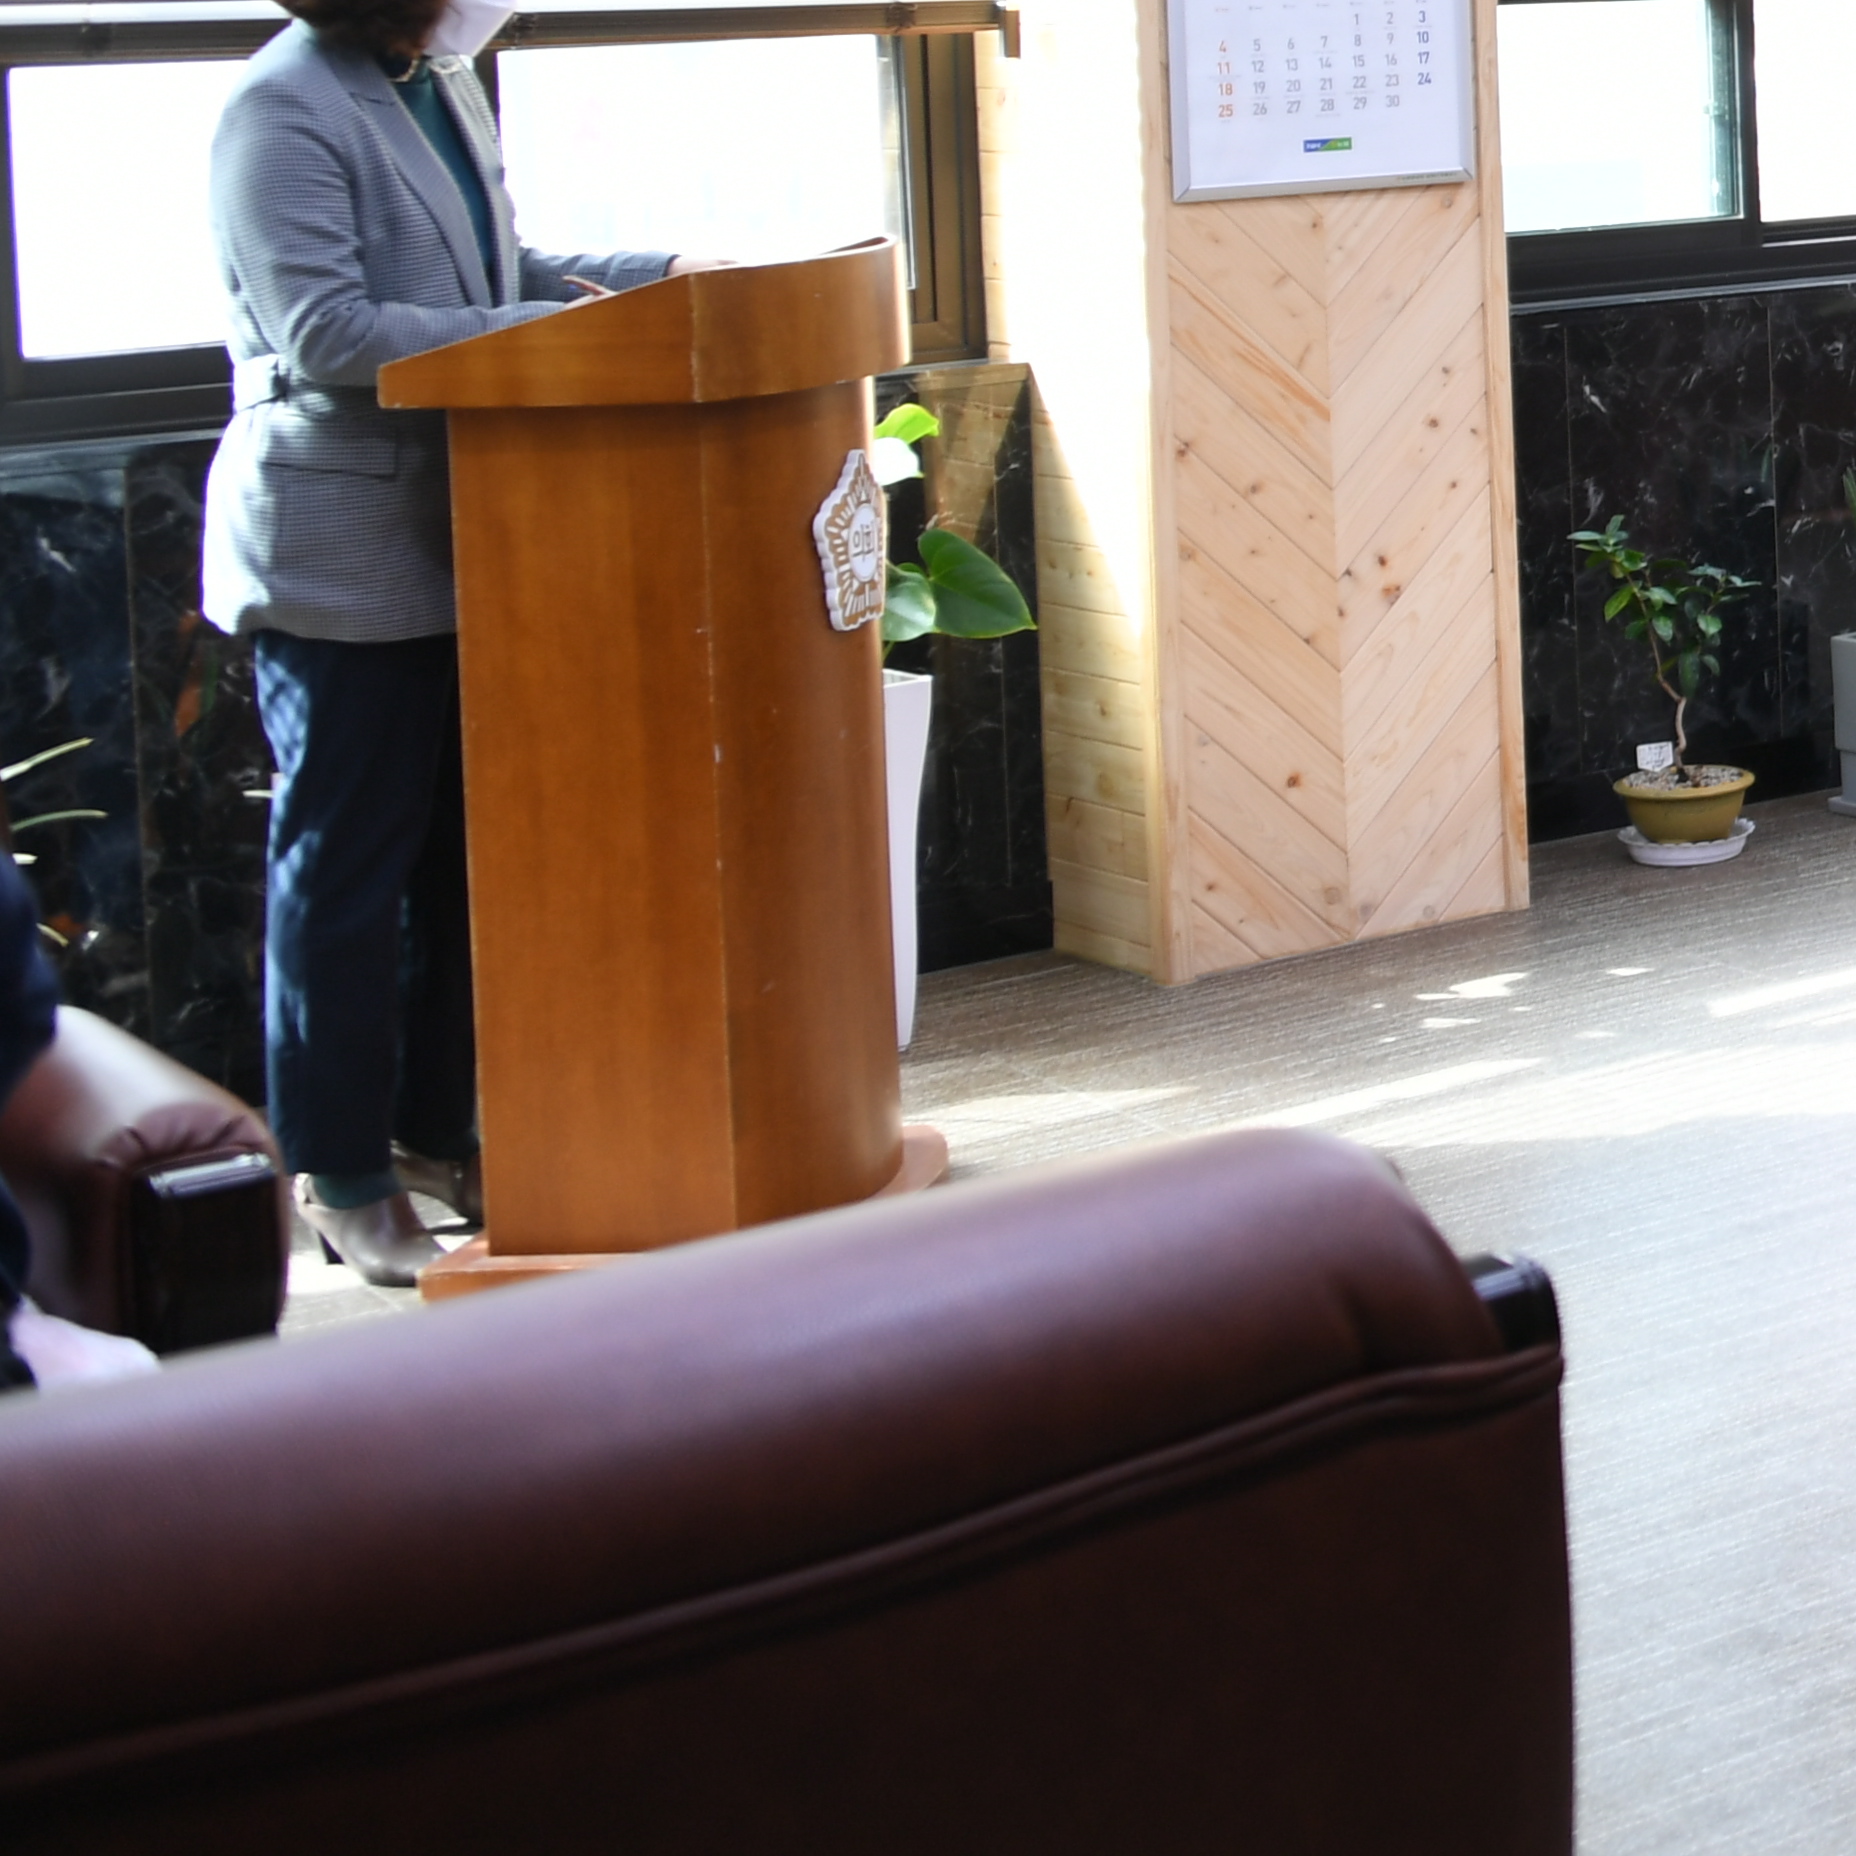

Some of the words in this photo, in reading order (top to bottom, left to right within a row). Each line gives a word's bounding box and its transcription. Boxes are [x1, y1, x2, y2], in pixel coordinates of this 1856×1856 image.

[1355, 14, 1359, 25] 1
[1387, 12, 1393, 24] 2
[1419, 11, 1426, 23] 3
[1219, 41, 1227, 52] 4
[1253, 39, 1261, 51] 5
[1288, 38, 1295, 50] 6
[1321, 36, 1328, 47] 7
[1354, 34, 1361, 46] 8
[1387, 33, 1394, 44] 9
[1417, 31, 1429, 43] 10
[1218, 62, 1230, 74] 11
[1251, 60, 1264, 73] 12
[1286, 58, 1298, 71] 13
[1319, 57, 1332, 69] 14
[1353, 54, 1365, 67] 15
[1385, 54, 1397, 65] 16
[1418, 51, 1429, 64] 17
[1219, 83, 1233, 96] 18
[1253, 81, 1265, 94] 19
[1286, 79, 1301, 92] 20
[1320, 78, 1332, 90] 21
[1353, 76, 1366, 89] 22
[1385, 74, 1399, 87] 23
[1418, 73, 1431, 85] 24
[1219, 104, 1233, 117] 25
[1253, 103, 1267, 115] 26
[1287, 100, 1301, 114] 27
[1321, 99, 1334, 111] 28
[1354, 97, 1367, 109] 29
[1386, 95, 1400, 107] 30
